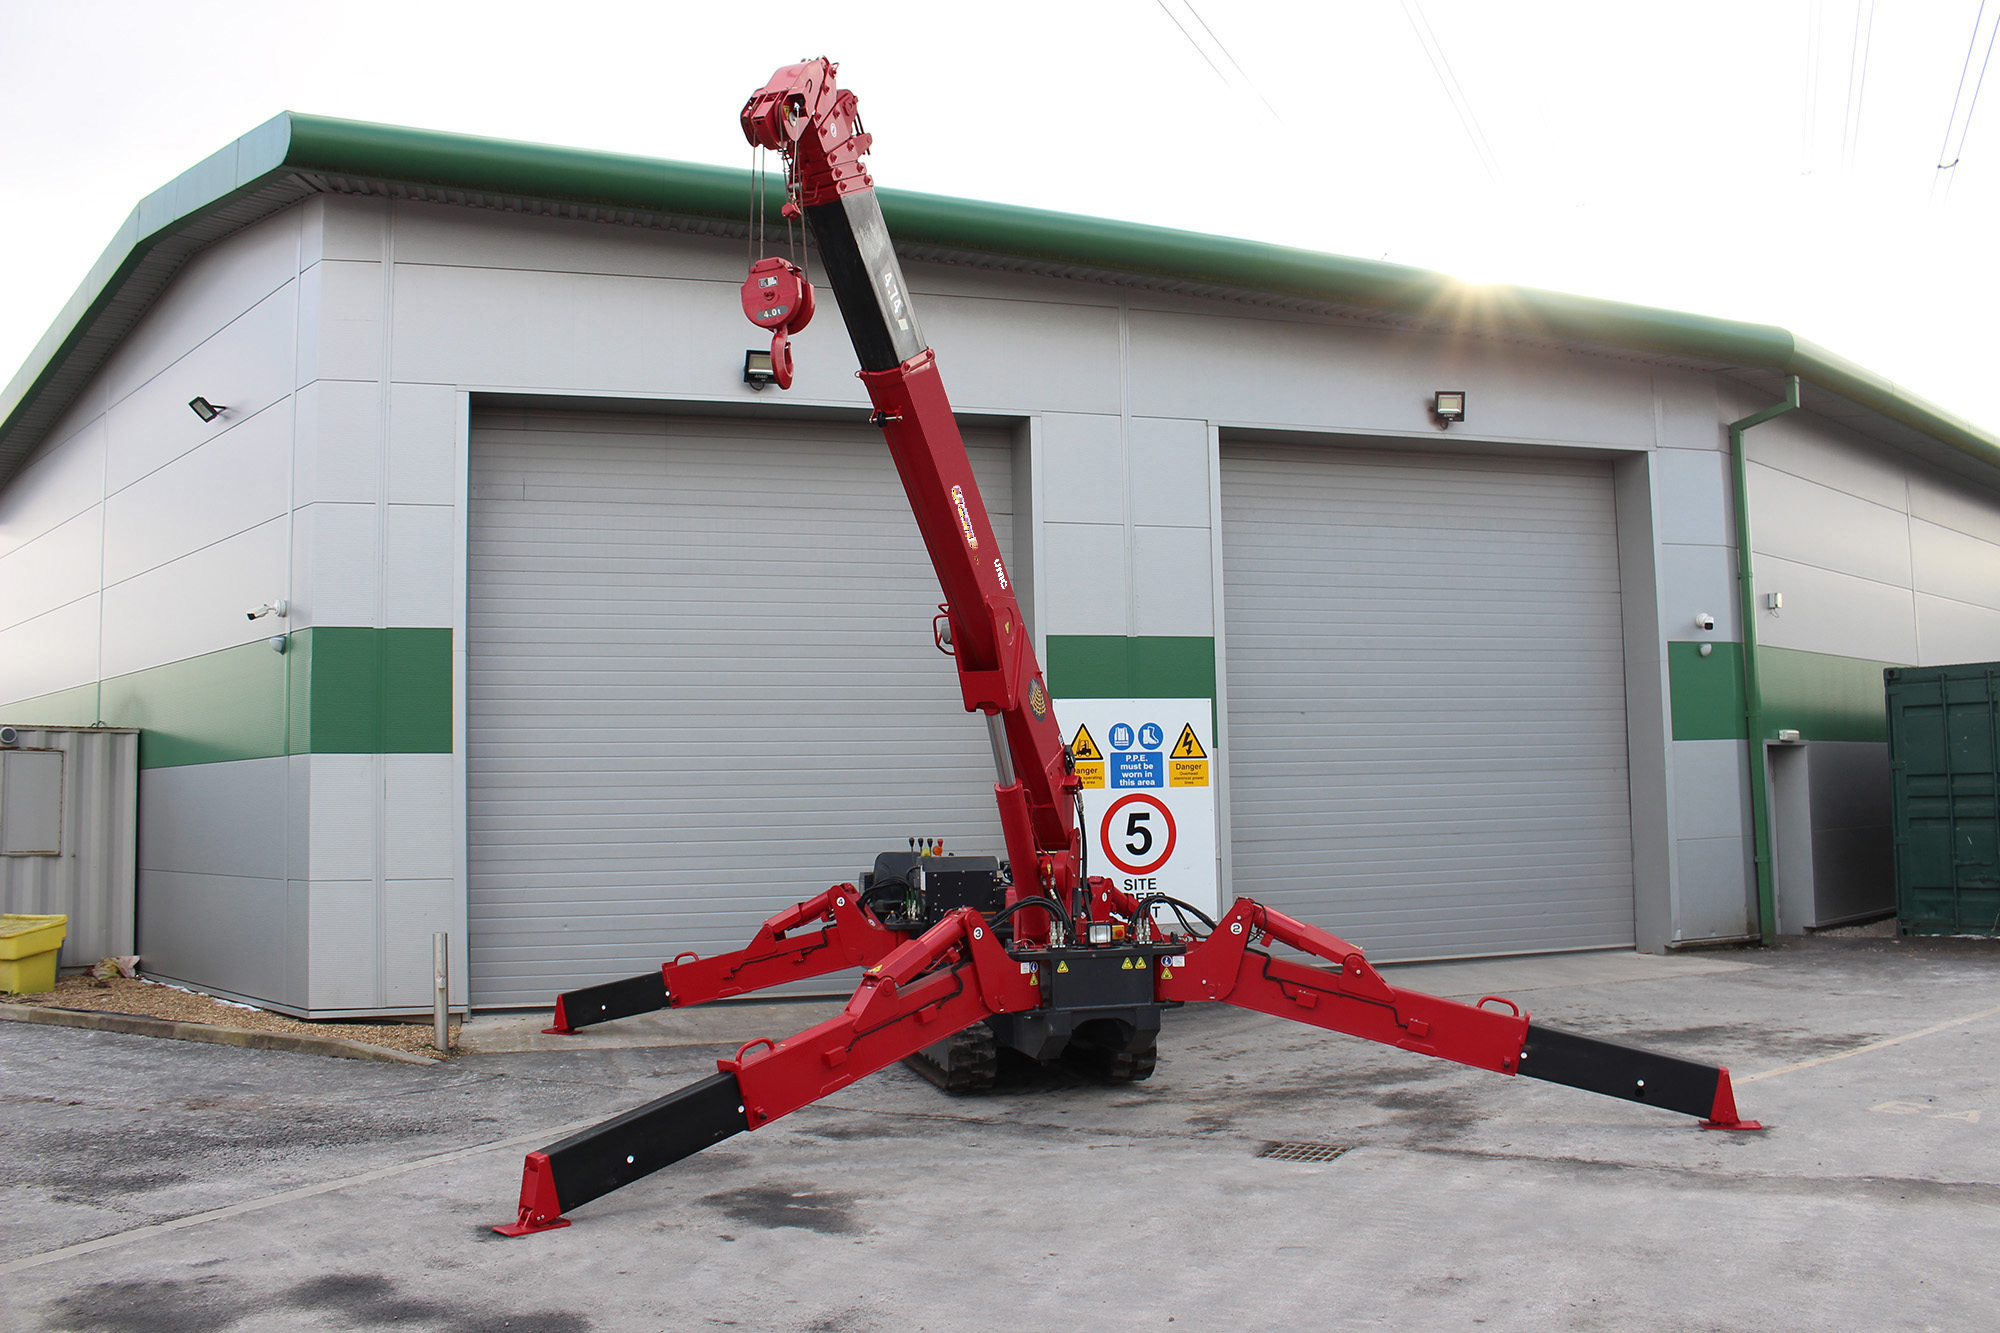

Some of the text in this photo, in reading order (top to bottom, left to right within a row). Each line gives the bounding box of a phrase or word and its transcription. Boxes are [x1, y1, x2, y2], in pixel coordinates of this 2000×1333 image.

[763, 309, 781, 318] 4.0t
[1125, 754, 1149, 762] P.P.E.
[1175, 763, 1202, 771] Danger
[1126, 812, 1153, 856] 5
[1123, 877, 1157, 891] SITE
[1232, 924, 1240, 933] 2
[975, 929, 981, 938] 3
